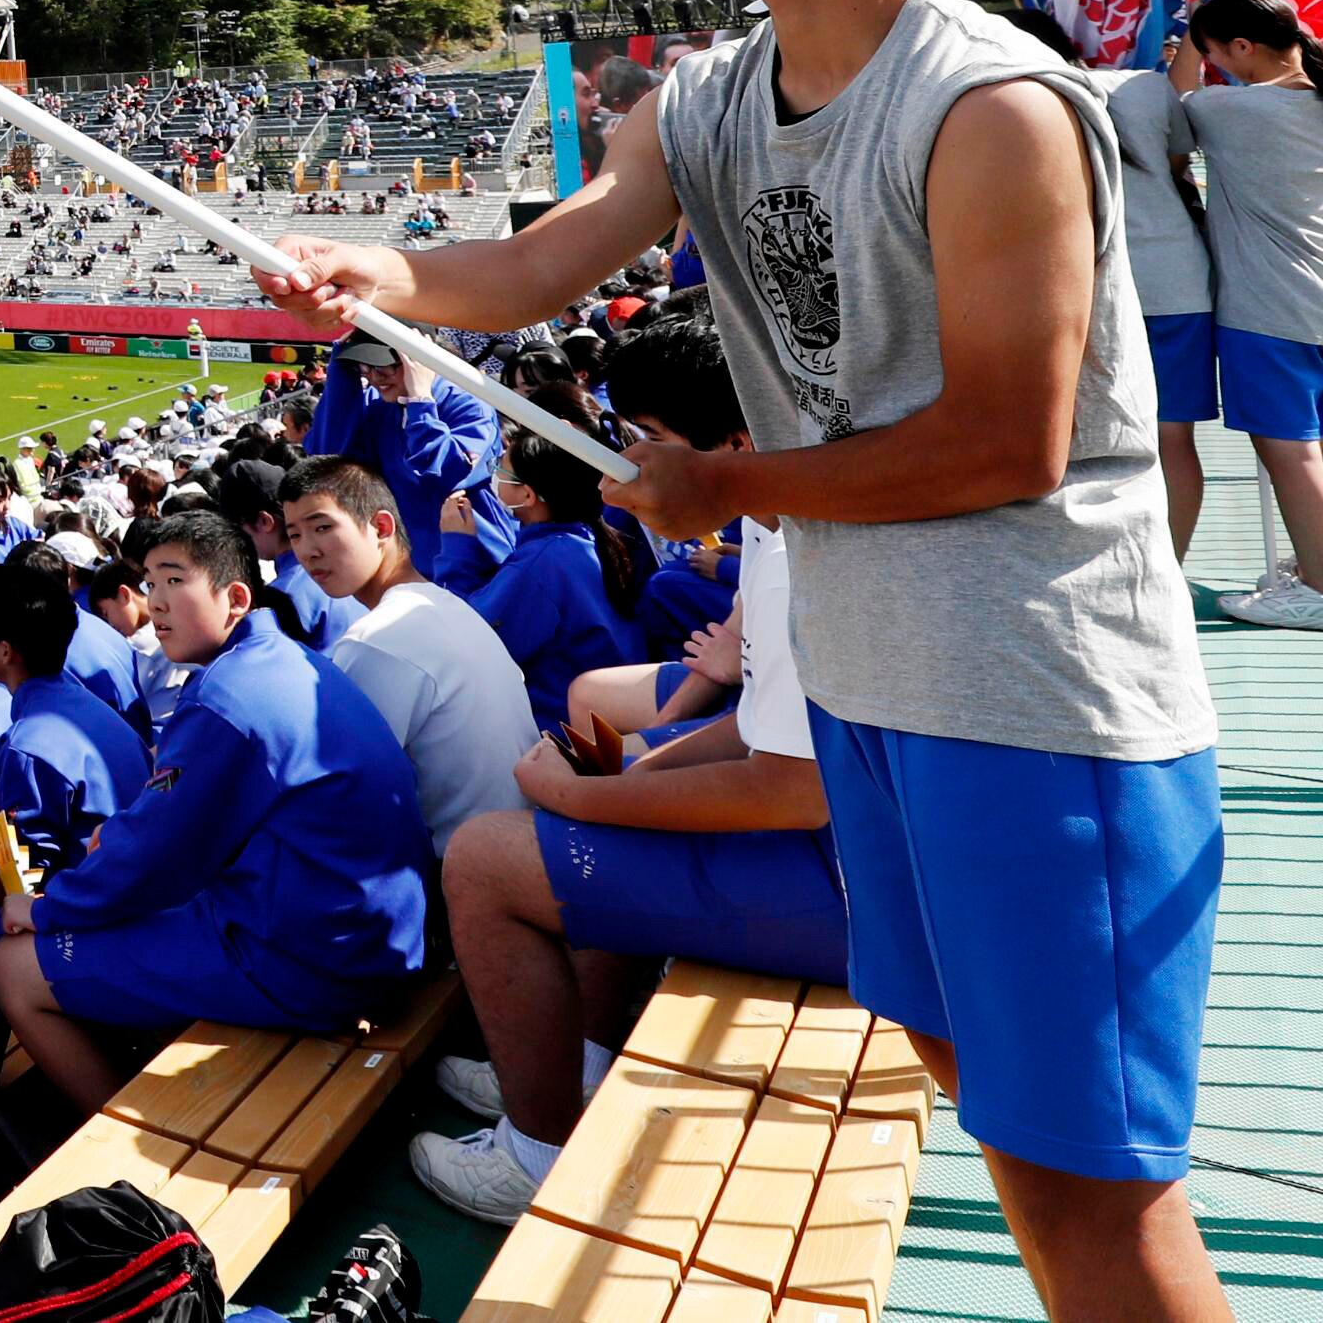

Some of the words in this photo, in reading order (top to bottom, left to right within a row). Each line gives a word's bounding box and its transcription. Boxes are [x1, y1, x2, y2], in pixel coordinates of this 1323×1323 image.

[46, 308, 174, 330] #RWC2019
[80, 338, 116, 348] Emirates
[138, 349, 177, 359] Heineken
